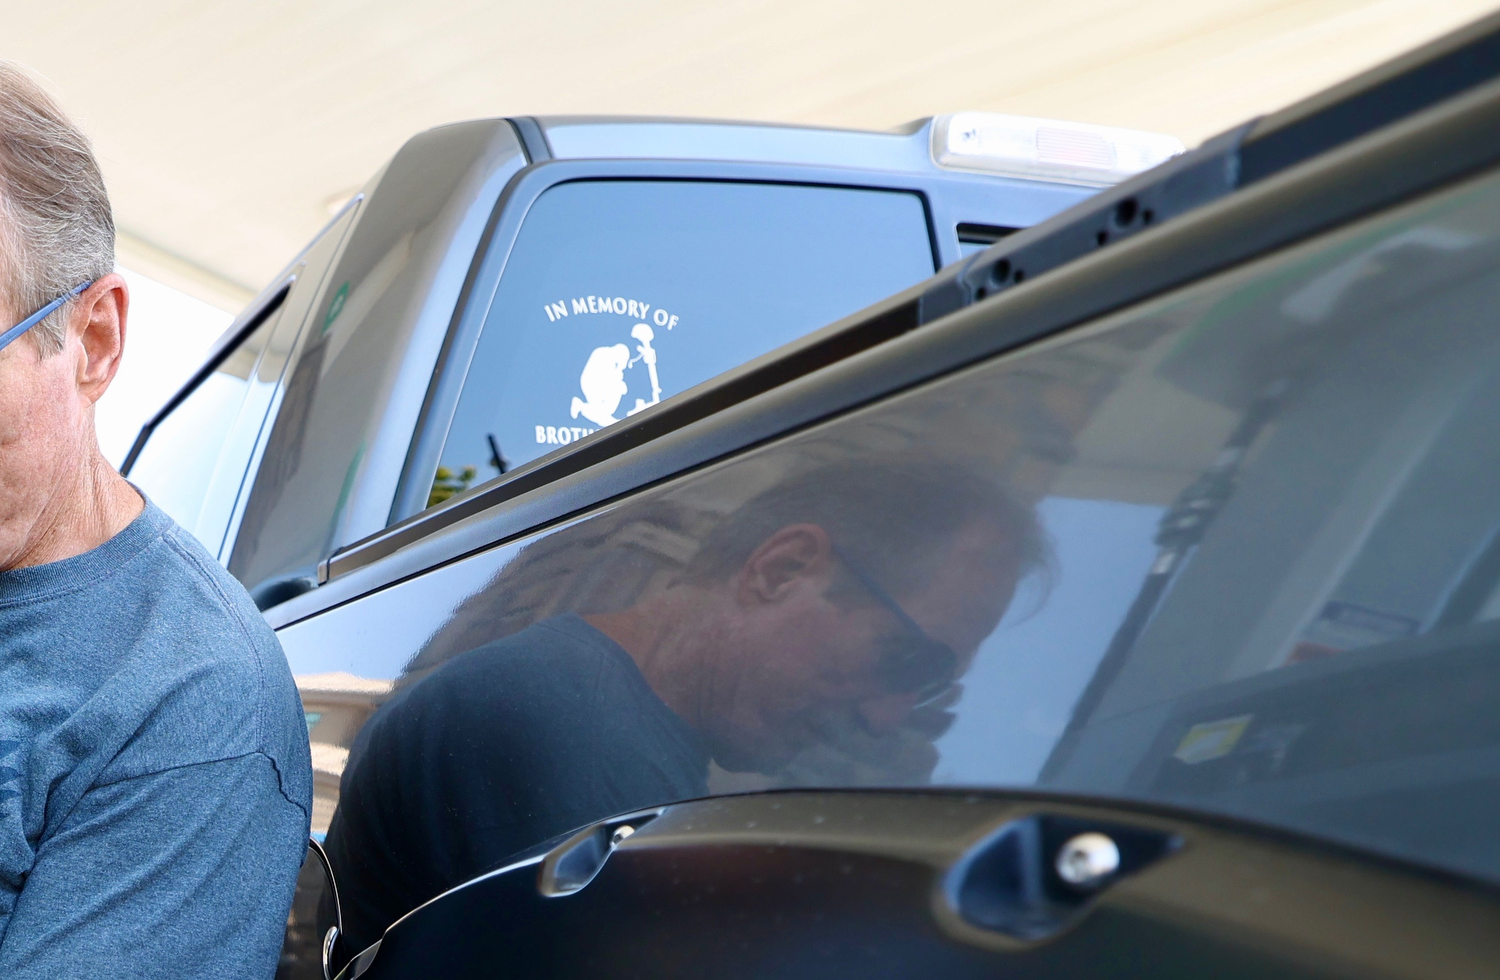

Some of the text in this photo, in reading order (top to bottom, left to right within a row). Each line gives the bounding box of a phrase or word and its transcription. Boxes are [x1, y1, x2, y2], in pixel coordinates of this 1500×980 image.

[544, 295, 678, 330] IN MEMORY OF
[535, 425, 600, 446] BROT
